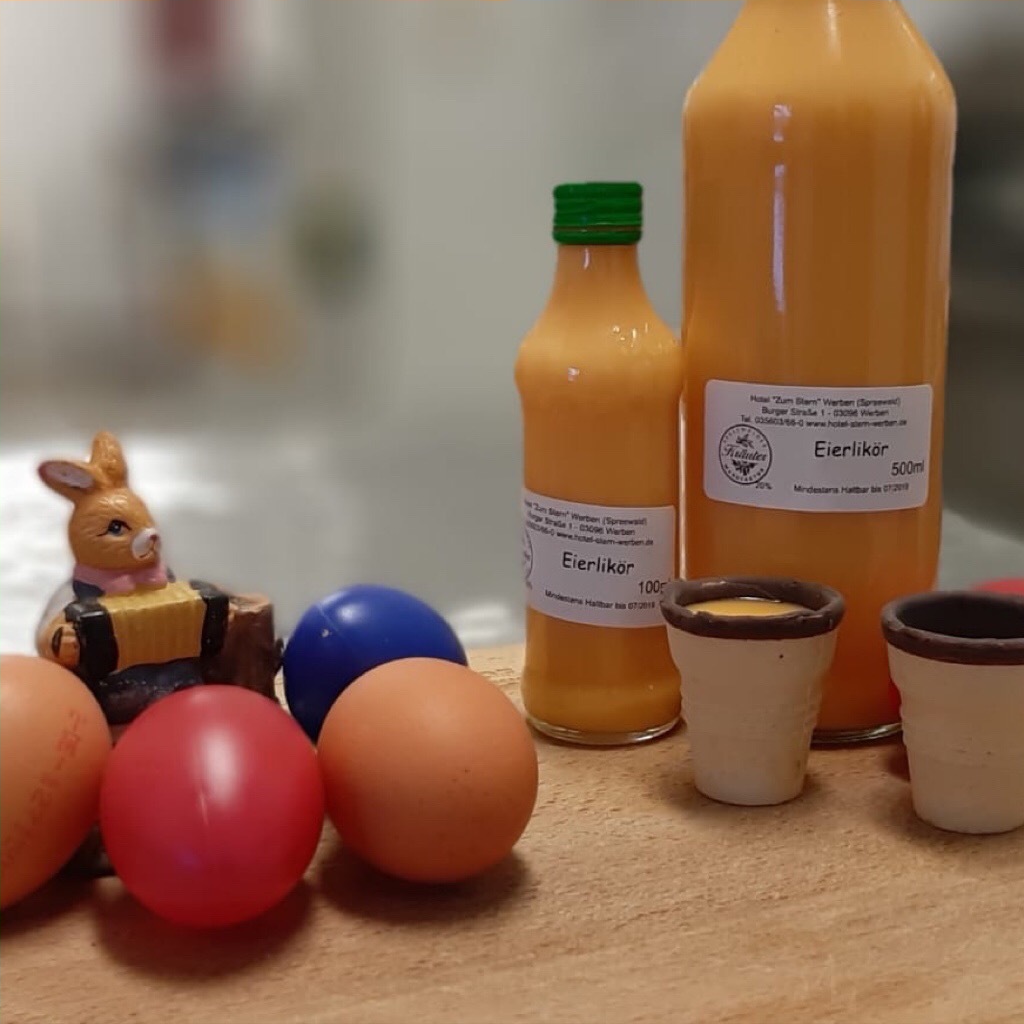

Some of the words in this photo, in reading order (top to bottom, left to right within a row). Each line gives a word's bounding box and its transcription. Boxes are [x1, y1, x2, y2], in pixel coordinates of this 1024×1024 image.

[822, 398, 855, 406] Werben
[814, 440, 889, 458] Eierlikör
[891, 460, 925, 476] 500ml
[793, 484, 838, 494] Mindestens
[871, 485, 881, 493] bis
[571, 512, 601, 523] Werben
[605, 527, 635, 536] Werben
[561, 551, 635, 575] Eierlikör
[615, 601, 626, 610] bis
